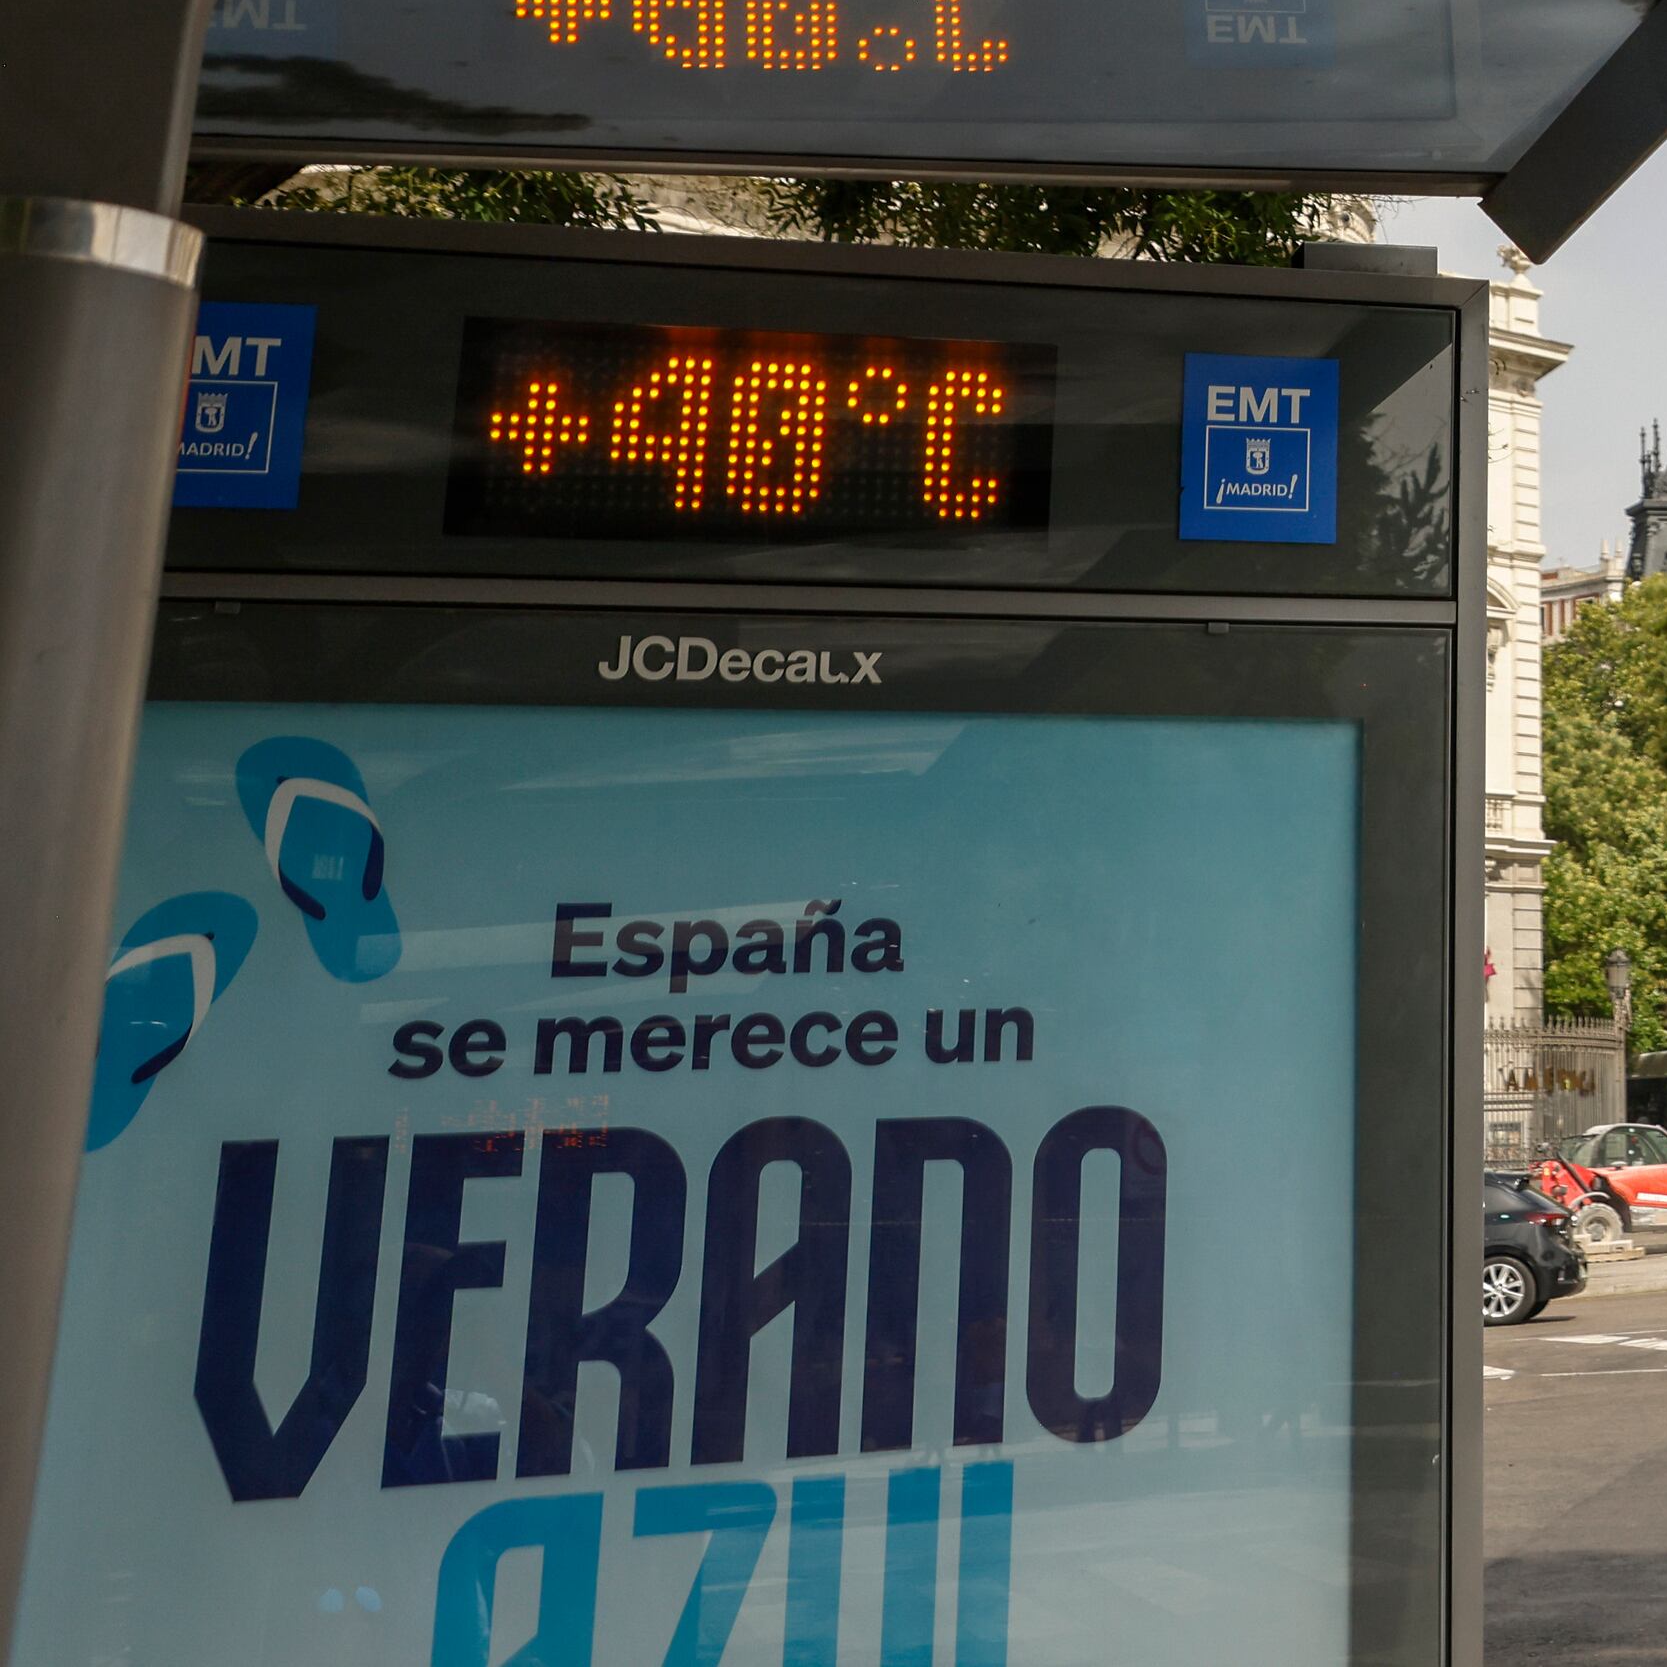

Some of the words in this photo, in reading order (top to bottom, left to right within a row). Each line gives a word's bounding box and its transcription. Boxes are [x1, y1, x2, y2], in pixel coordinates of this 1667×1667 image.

[191, 335, 282, 377] MT
[1207, 385, 1310, 424] EMT
[177, 430, 258, 460] ADRID!
[489, 356, 1004, 518] +40°C
[1216, 474, 1298, 504] ¡MADRID!
[550, 897, 905, 994] España
[387, 1022, 507, 1079] se
[533, 1008, 900, 1076] merece
[923, 1005, 1036, 1064] un
[192, 1104, 1168, 1503] VERANO
